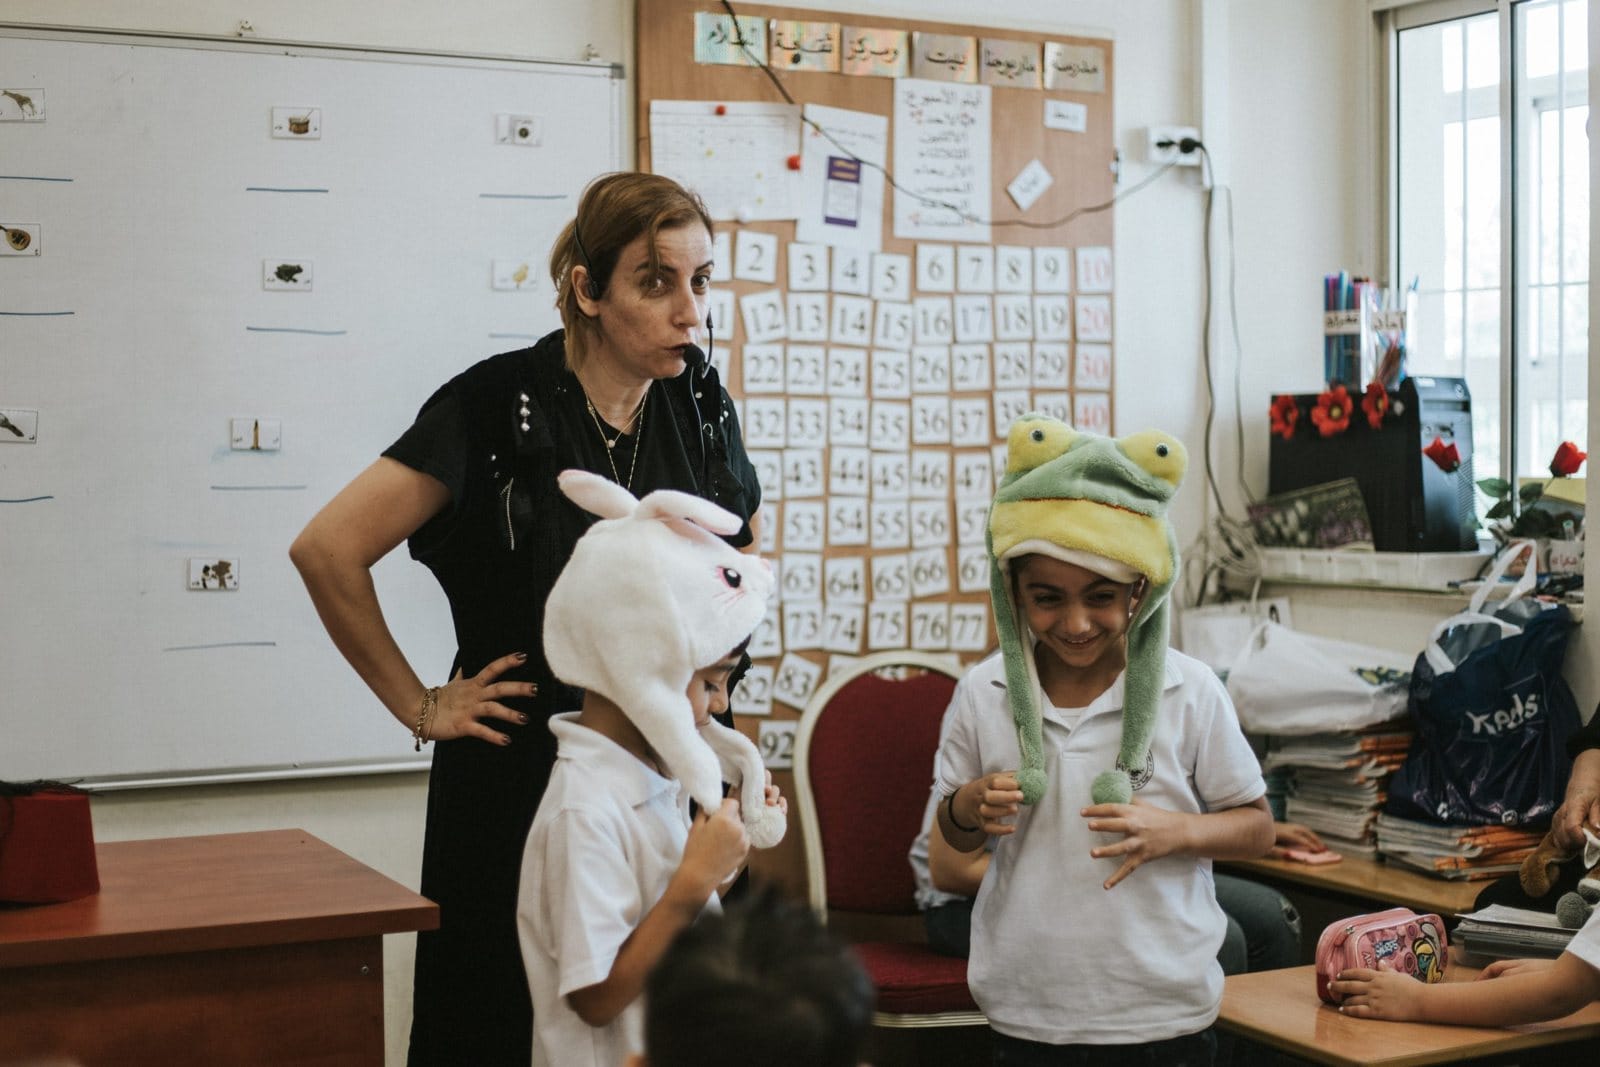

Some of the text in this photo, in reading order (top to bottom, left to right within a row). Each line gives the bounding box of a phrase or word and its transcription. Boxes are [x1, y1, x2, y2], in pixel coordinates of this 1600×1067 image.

[925, 50, 967, 71] بيت
[748, 244, 1112, 292] 2 3 4 5 6 7 8 9 10
[751, 302, 781, 335] 12
[795, 304, 822, 332] 13
[839, 308, 866, 335] 14
[883, 312, 909, 341] 15
[921, 308, 951, 336] 16
[961, 304, 988, 333] 17
[1003, 306, 1029, 332] 18
[1041, 304, 1067, 332] 19
[1080, 304, 1110, 333] 20
[748, 355, 779, 384] 22
[791, 356, 821, 386] 23
[830, 359, 862, 386] 24
[876, 361, 905, 390] 25
[917, 356, 946, 384] 26
[957, 354, 985, 383] 27
[1000, 354, 1027, 380] 28
[1035, 353, 1064, 380] 29
[1081, 353, 1110, 380] 30
[750, 410, 780, 437] 32
[792, 411, 821, 438] 33
[834, 407, 863, 437] 34
[877, 412, 905, 440] 35
[919, 408, 947, 437] 36
[957, 410, 985, 437] 37
[1077, 402, 1109, 428] 40
[785, 462, 817, 489] 43
[831, 461, 863, 485] 44
[873, 465, 904, 492] 45
[913, 463, 945, 488] 46
[958, 464, 987, 490] 47
[790, 514, 818, 542] 53
[835, 508, 863, 533] 54
[876, 512, 905, 539] 55
[915, 512, 945, 539] 56
[961, 508, 988, 537] 57
[784, 556, 989, 595] 63 64 65 66 67
[790, 611, 819, 640] 73
[830, 614, 859, 642] 74
[875, 611, 903, 640] 75
[915, 613, 946, 640] 76
[954, 613, 983, 640] 77
[737, 666, 811, 704] 82 83
[761, 732, 793, 759] 92
